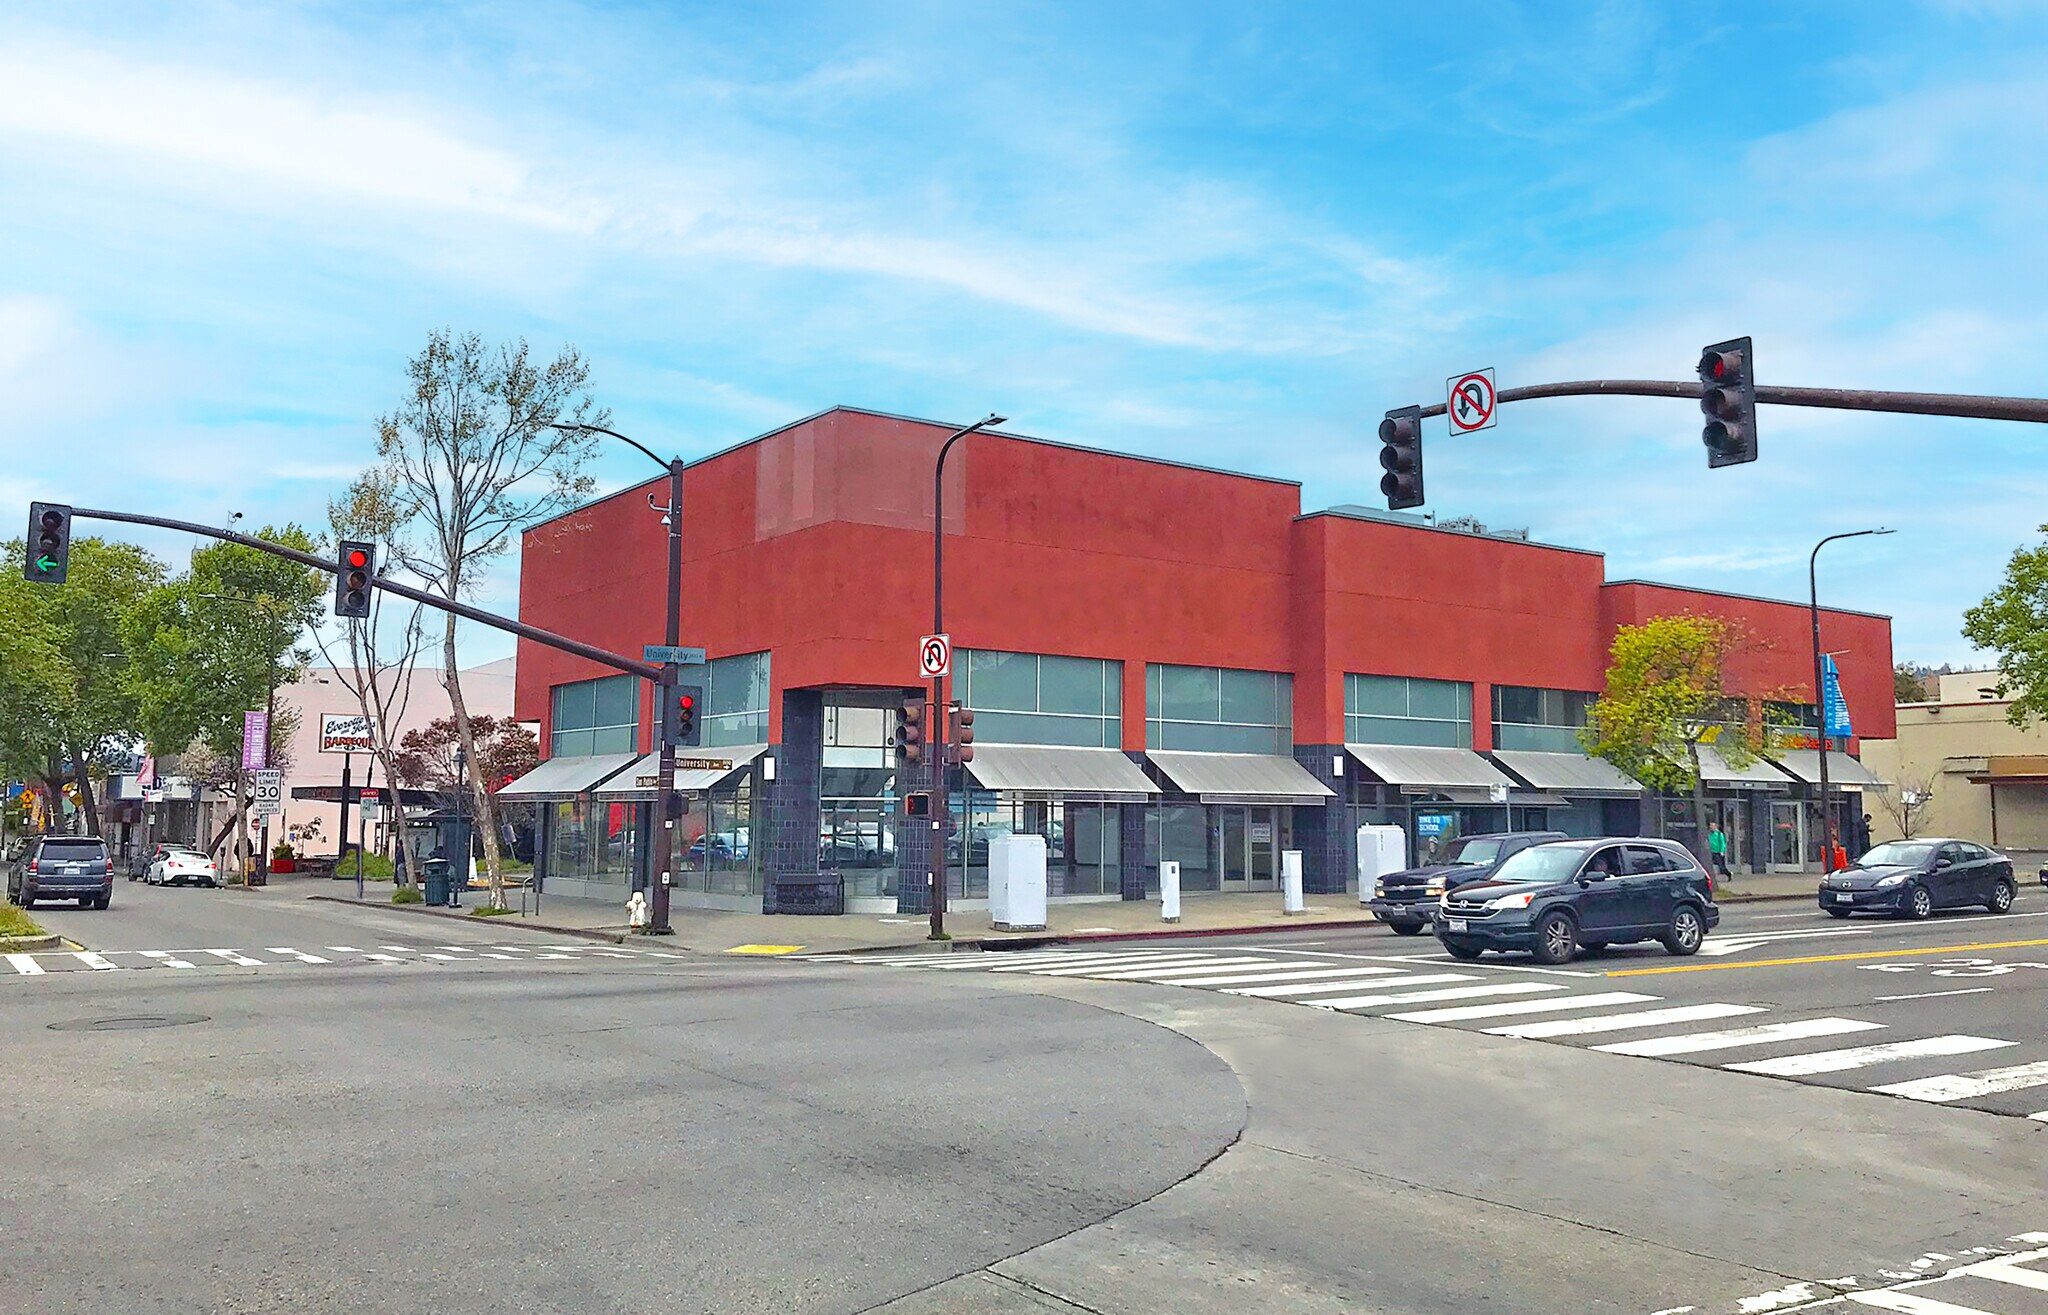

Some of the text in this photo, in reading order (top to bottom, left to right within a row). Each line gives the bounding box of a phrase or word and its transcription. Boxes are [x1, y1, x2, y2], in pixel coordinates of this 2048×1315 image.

[646, 649, 689, 661] Univerity
[351, 720, 376, 735] Jons
[250, 715, 265, 766] INTERNATIONAL
[675, 758, 710, 769] University
[257, 786, 279, 798] 30
